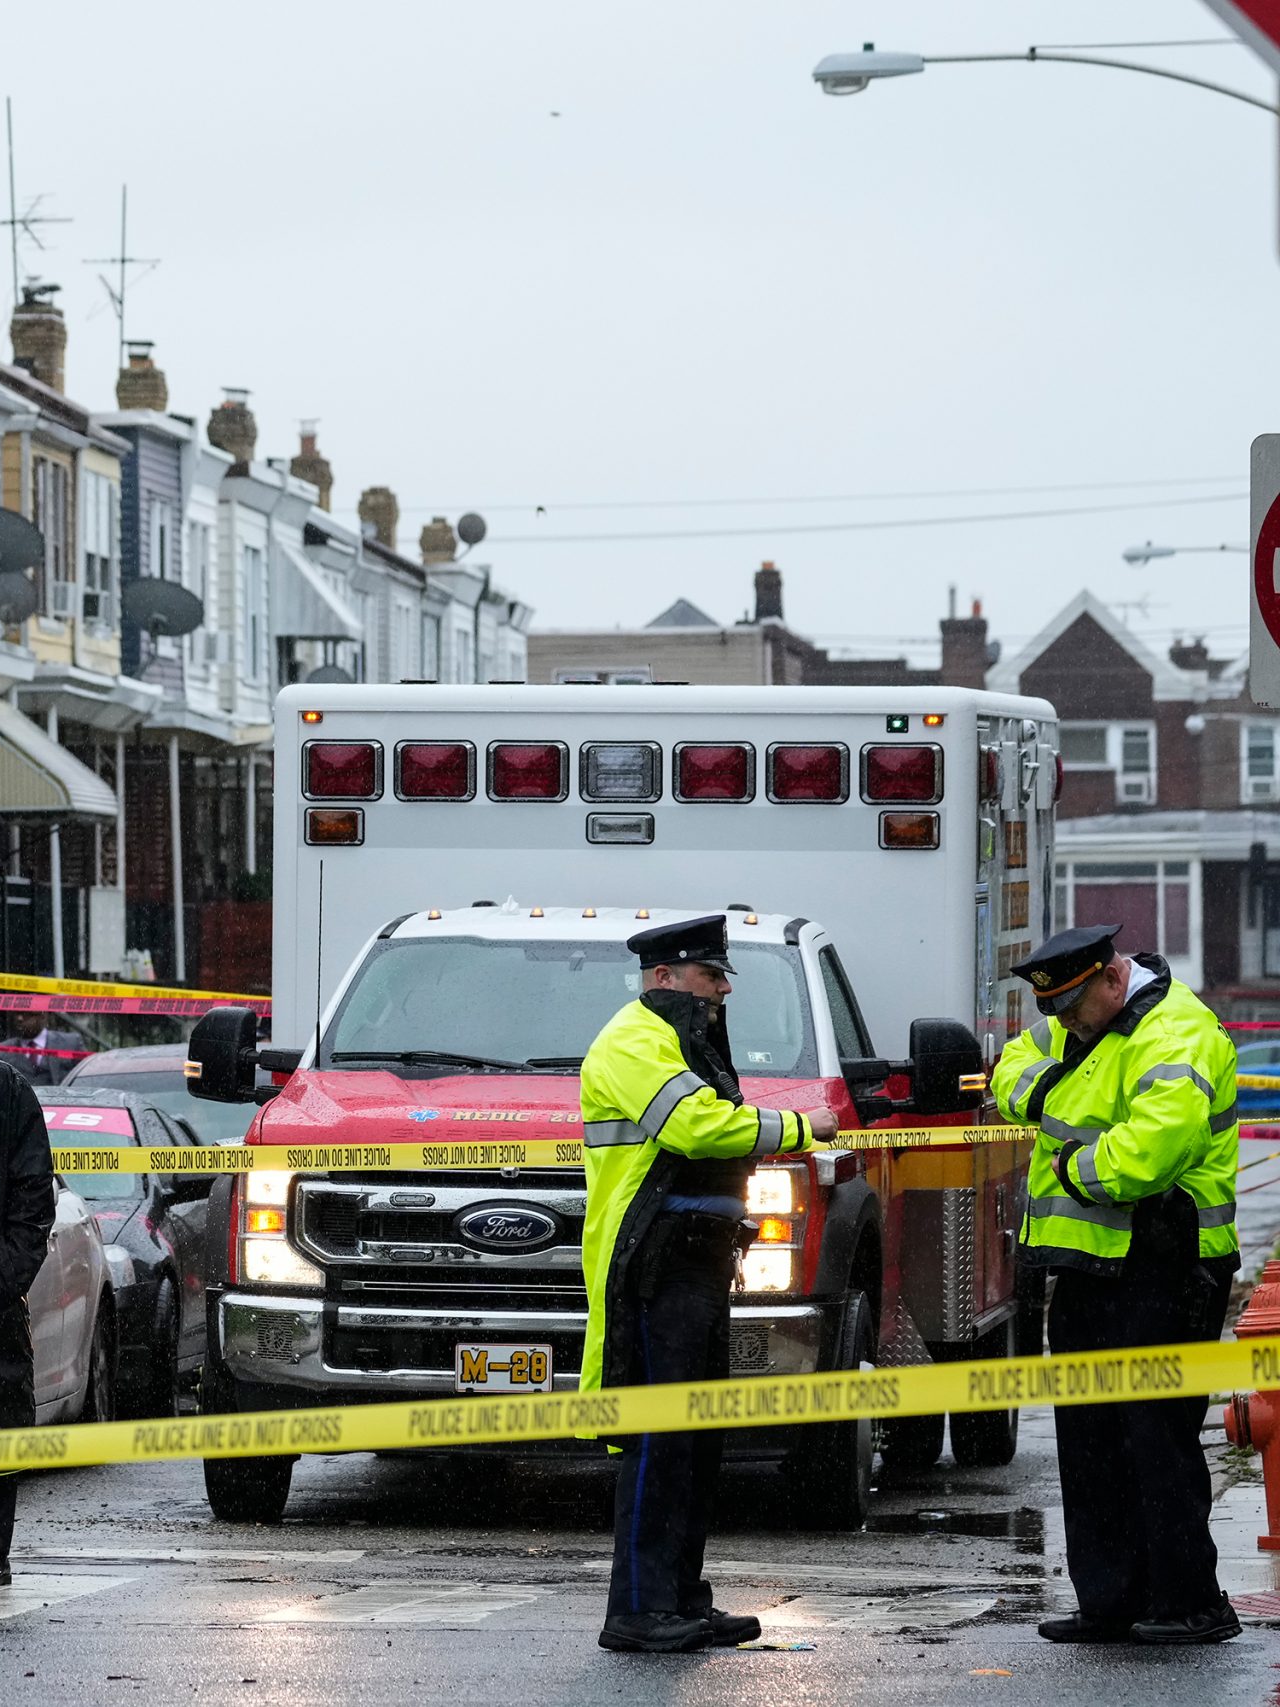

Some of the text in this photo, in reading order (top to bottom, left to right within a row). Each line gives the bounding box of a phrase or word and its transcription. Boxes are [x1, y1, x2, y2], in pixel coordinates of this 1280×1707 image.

[452, 1110, 581, 1123] MEDIC 28
[856, 1135, 870, 1149] NOT
[872, 1135, 883, 1148] DO
[885, 1133, 902, 1147] LINE
[904, 1132, 931, 1146] POLICE
[963, 1130, 989, 1144] CROSS
[992, 1129, 1007, 1143] NOT
[60, 1152, 70, 1170] DO
[73, 1152, 90, 1169] LINE
[92, 1152, 119, 1169] POLICE
[150, 1150, 253, 1170] POLICE LINE DO NOT CROSS
[287, 1148, 390, 1168] POLICE LINE DO NOT CROSS
[423, 1145, 526, 1165] POLICE LINE DO NOT CROSS
[556, 1144, 582, 1162] CROSS
[482, 1215, 533, 1238] Ford
[460, 1350, 548, 1384] M-28
[1251, 1347, 1280, 1381] POL
[968, 1355, 1183, 1402] POLICE LINE DO NOT CROSS
[688, 1378, 900, 1421] POLICE LINE DO NOT CROSS
[408, 1397, 620, 1438] POLICE LINE DO NOT CROSS
[133, 1415, 342, 1453] POLICE LINE DO NOT CROSS
[17, 1432, 68, 1460] CROSS
